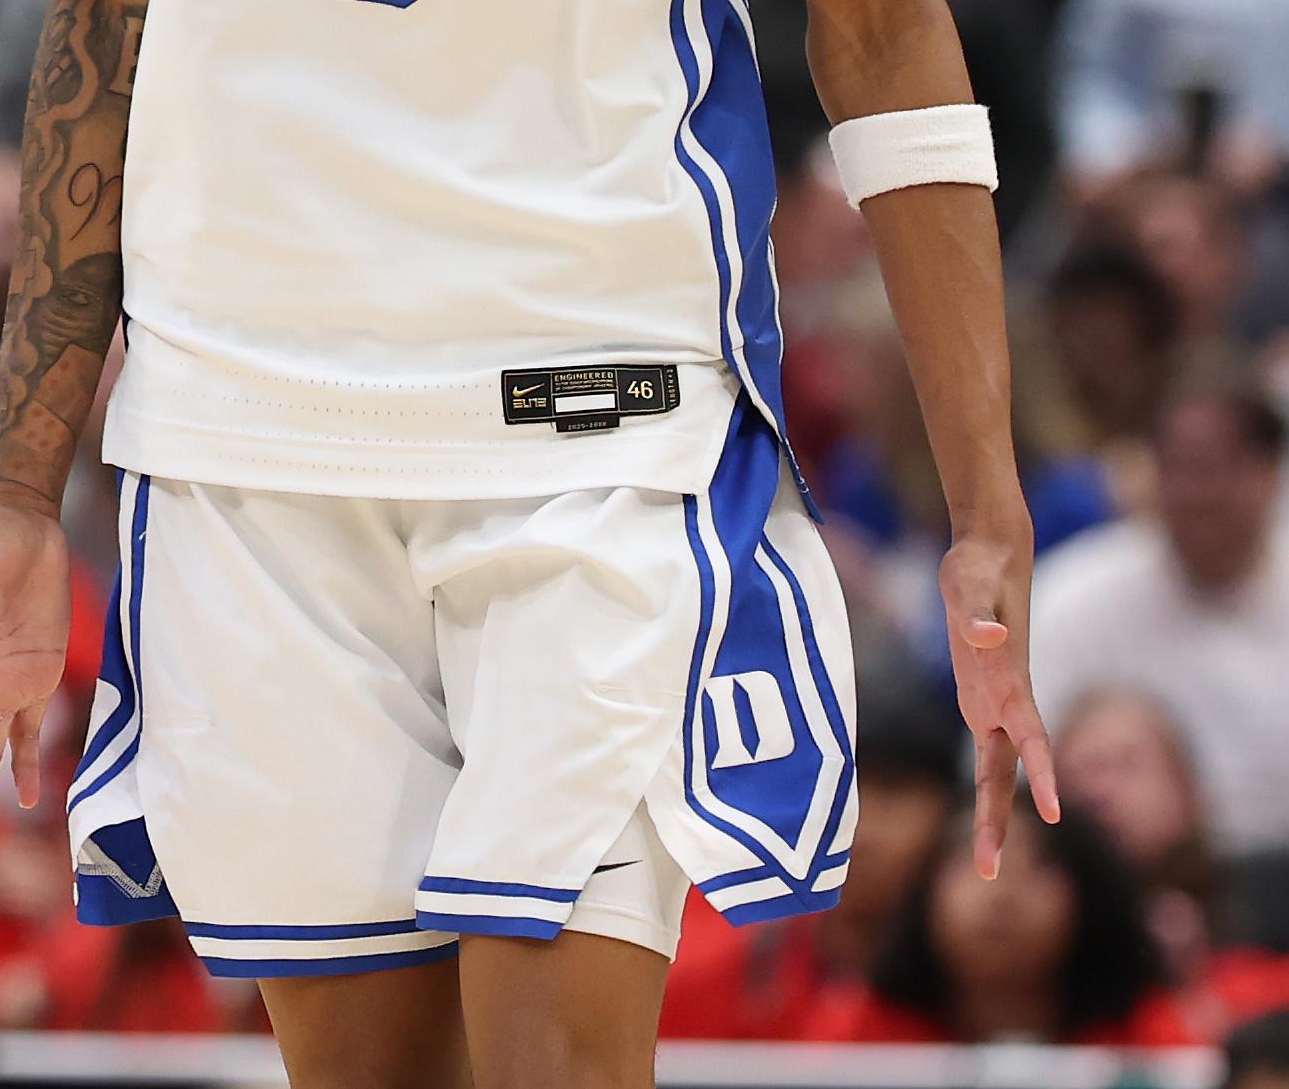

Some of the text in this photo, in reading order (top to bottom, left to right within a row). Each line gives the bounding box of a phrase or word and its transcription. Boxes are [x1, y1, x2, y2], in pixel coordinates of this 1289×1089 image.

[554, 371, 614, 382] ENGINEERED
[627, 380, 653, 399] 46
[708, 671, 795, 770] D
